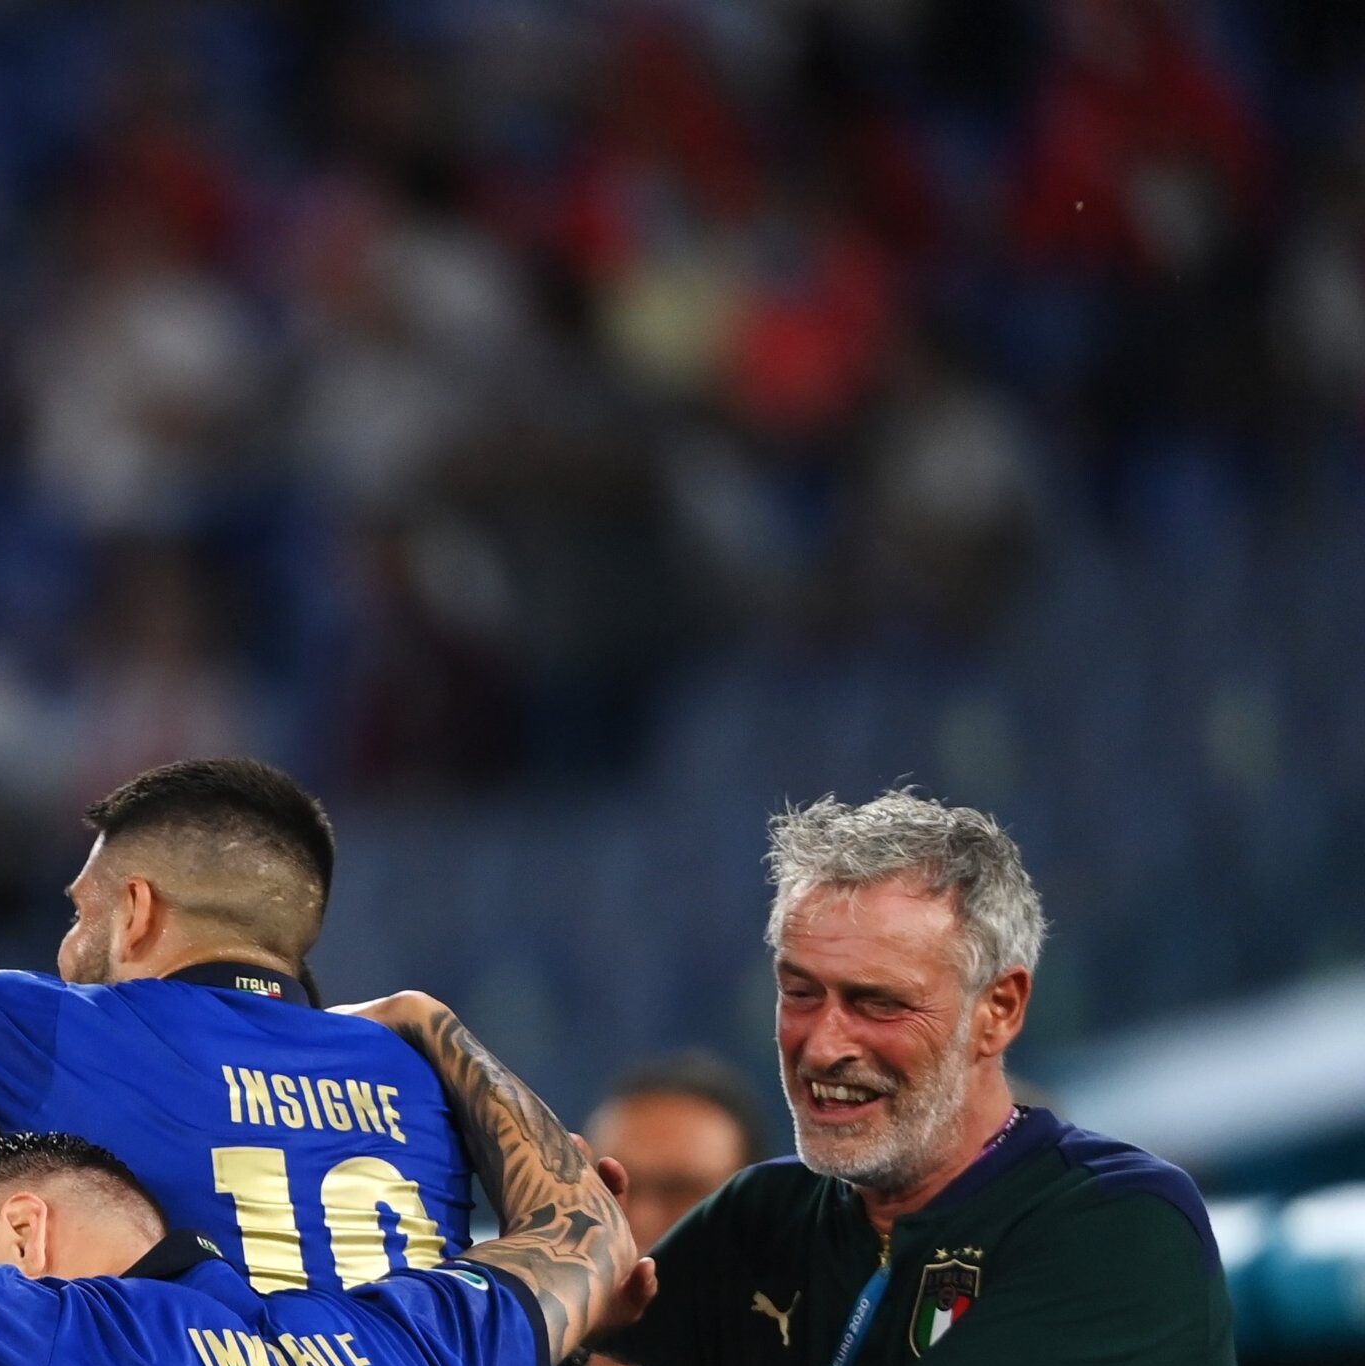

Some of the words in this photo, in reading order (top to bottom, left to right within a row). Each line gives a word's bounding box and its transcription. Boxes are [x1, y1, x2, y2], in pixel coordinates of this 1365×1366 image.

[235, 976, 281, 994] ITALIA
[221, 1065, 407, 1144] INSIGNE
[849, 1297, 870, 1335] 2020
